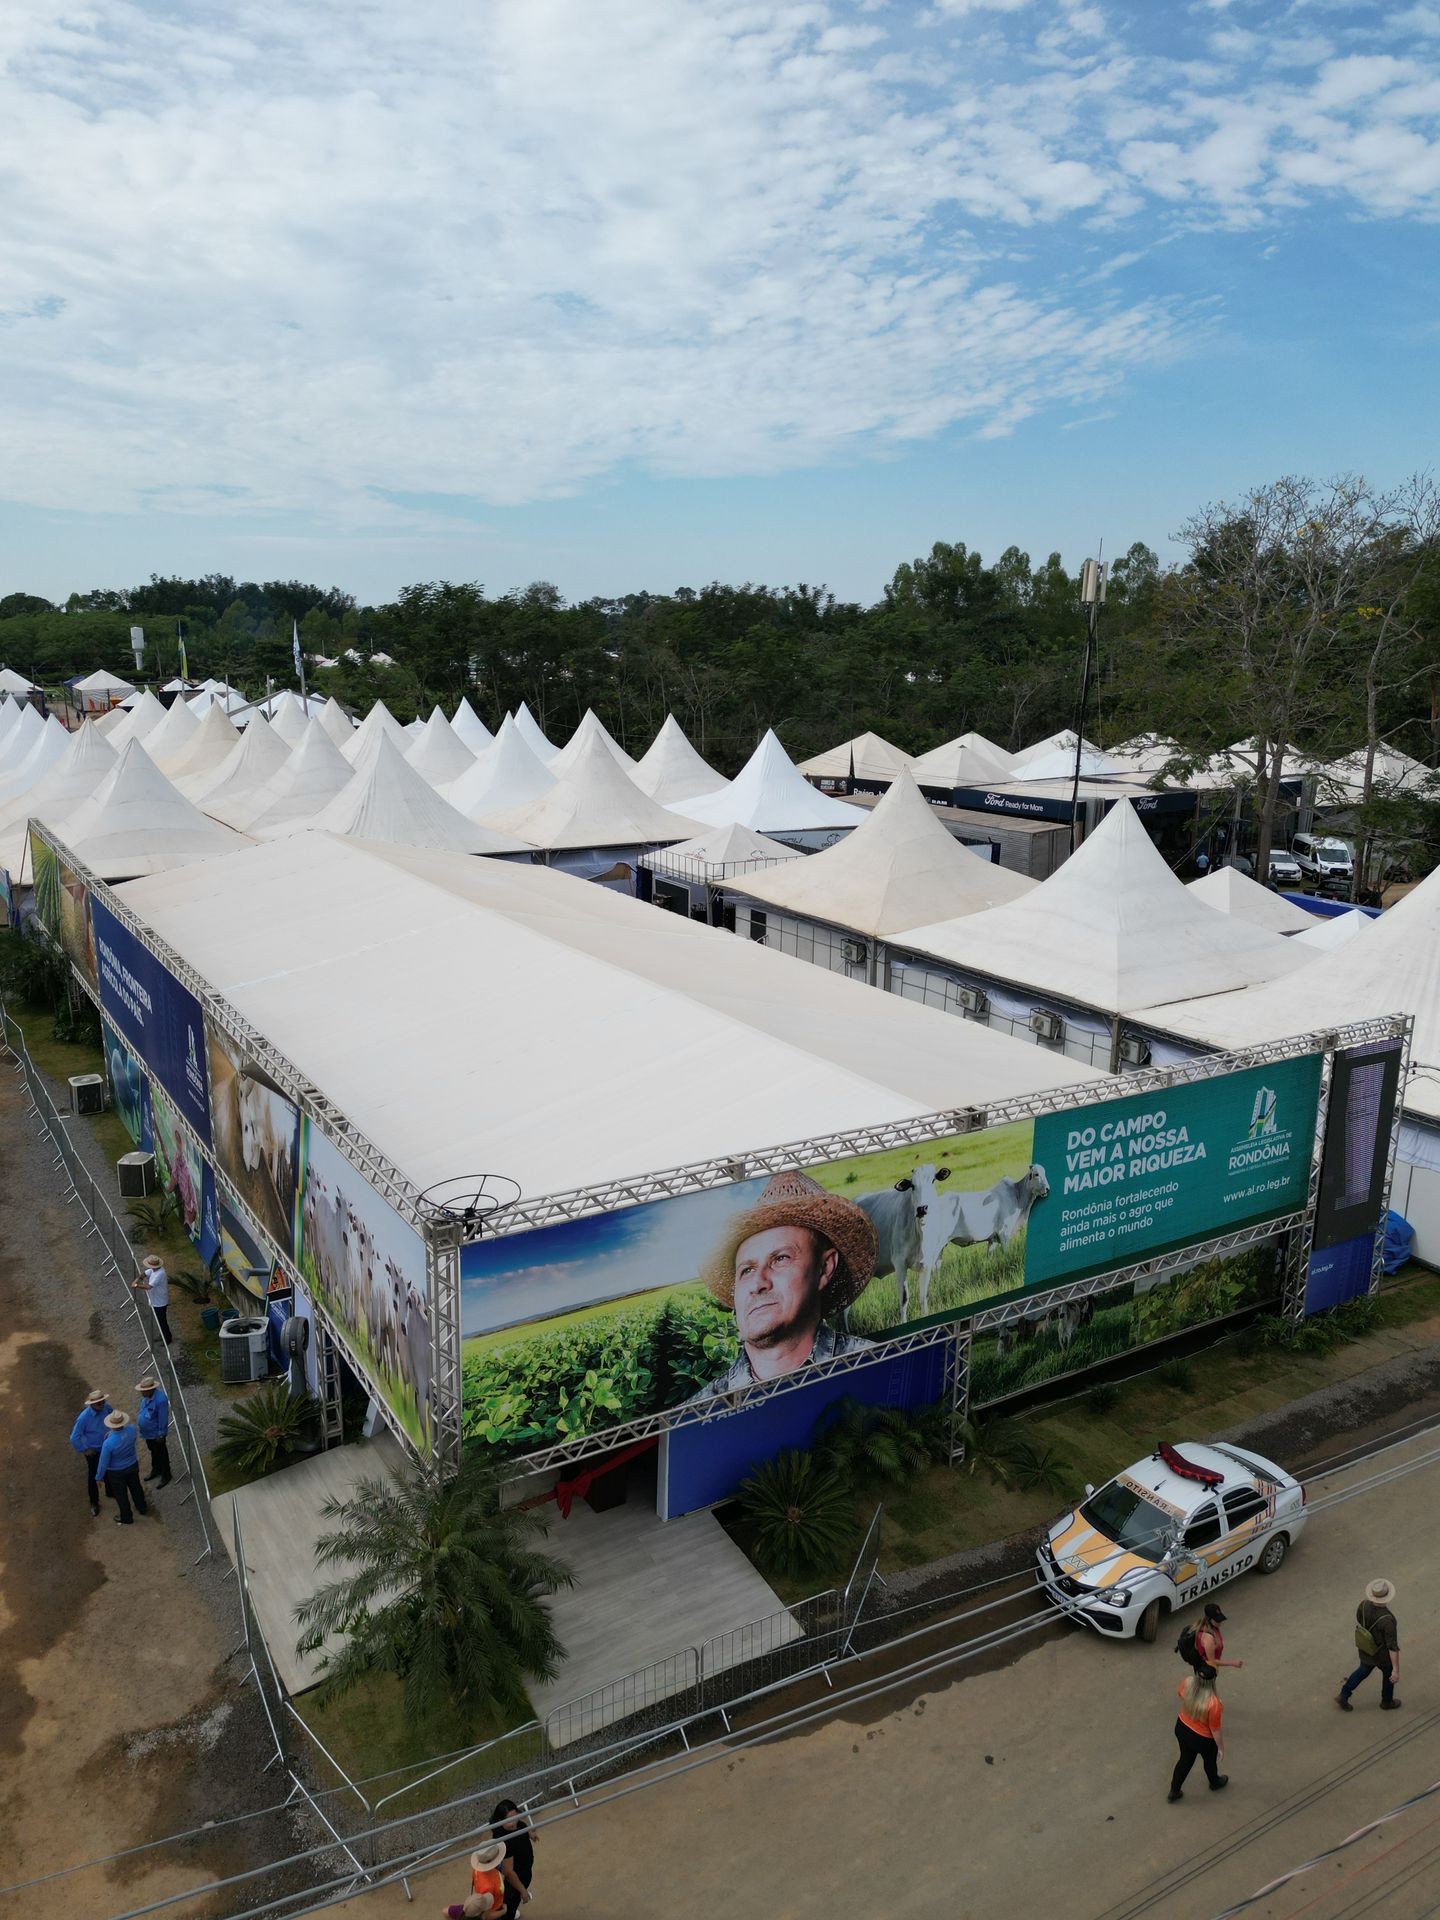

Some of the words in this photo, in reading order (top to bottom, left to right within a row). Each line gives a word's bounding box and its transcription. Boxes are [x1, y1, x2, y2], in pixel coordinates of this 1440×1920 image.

[984, 792, 1006, 807] Ford
[1005, 800, 1021, 811] Ready
[1022, 802, 1030, 810] for
[1030, 803, 1044, 812] More
[1137, 797, 1158, 811] Ford
[1065, 1146, 1106, 1172] VEM
[1110, 1142, 1124, 1162] A
[1128, 1126, 1189, 1157] NOSSA
[1067, 1127, 1096, 1150] DO
[1100, 1110, 1167, 1142] CAMPO
[1063, 1163, 1126, 1195] MAIOR
[1129, 1142, 1207, 1178] RIQUEZA
[1228, 1142, 1290, 1170] RONDÔNIA
[1062, 1200, 1113, 1222] Rondônia
[1115, 1181, 1179, 1208] fortalecendo
[1223, 1176, 1290, 1203] www.al.ro.leg.br
[1059, 1230, 1105, 1251] alimenta
[1108, 1228, 1115, 1238] o
[1117, 1216, 1153, 1235] mundo
[1060, 1220, 1090, 1237] ainda
[1092, 1212, 1117, 1228] mais
[1119, 1211, 1127, 1220] o
[1129, 1204, 1152, 1218] agro
[1154, 1196, 1174, 1211] que
[1179, 1554, 1253, 1603] TRÂNSITO
